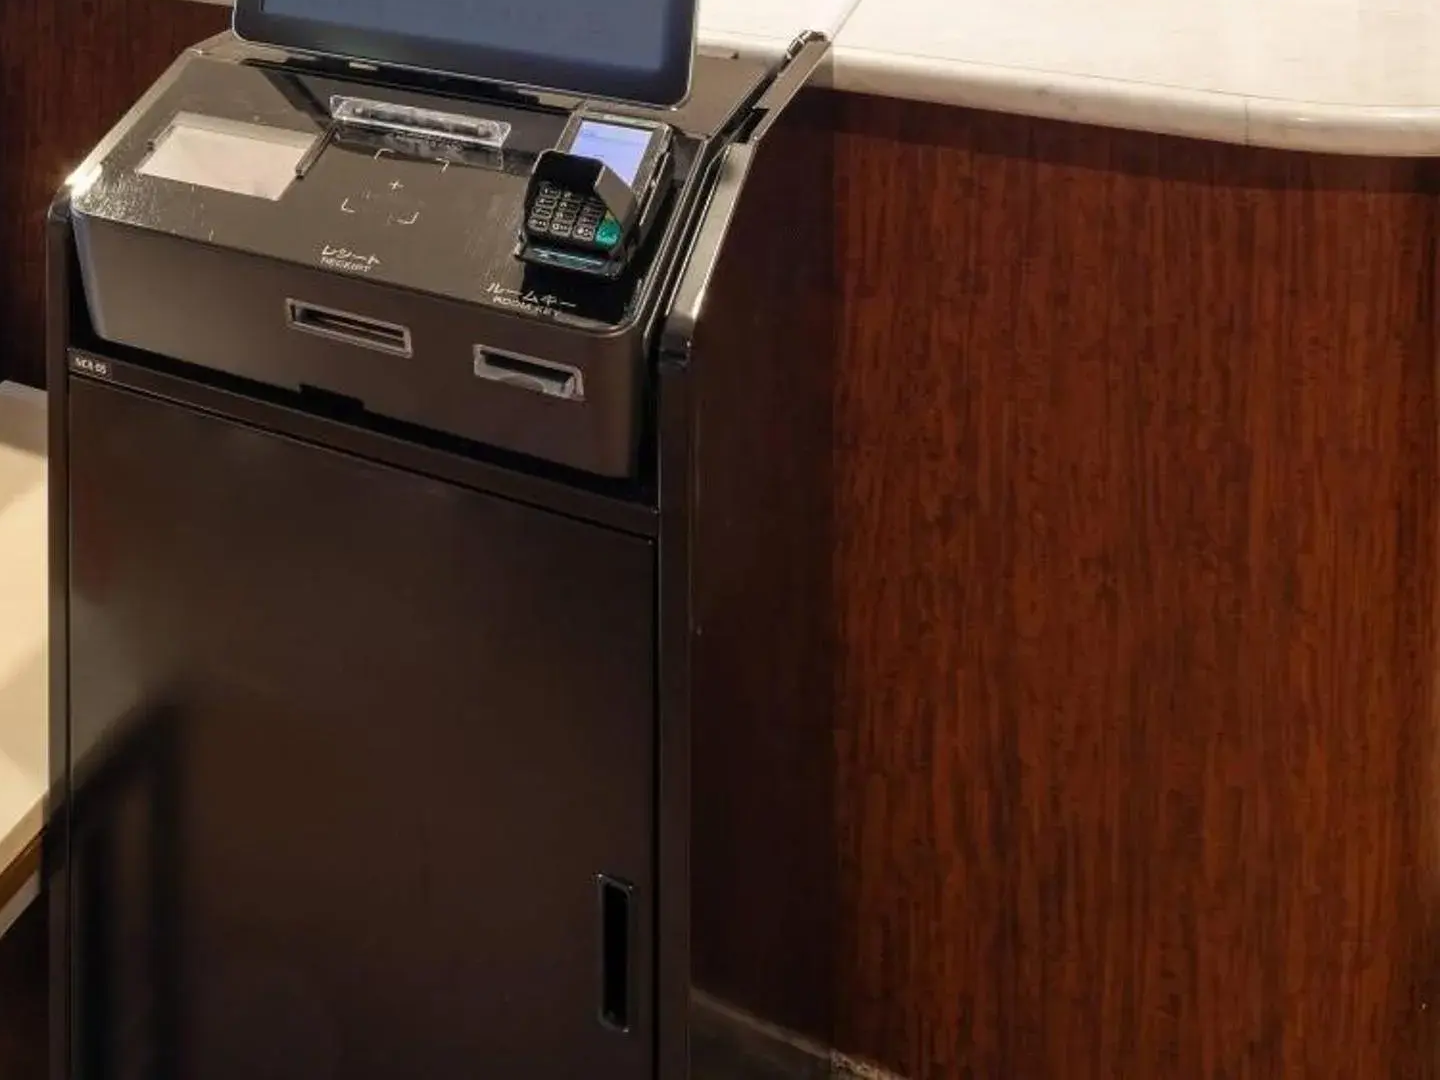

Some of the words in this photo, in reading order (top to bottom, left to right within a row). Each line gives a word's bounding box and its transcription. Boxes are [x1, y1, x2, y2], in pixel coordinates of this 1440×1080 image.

[321, 244, 381, 265] レシート
[486, 282, 577, 307] ルームキー
